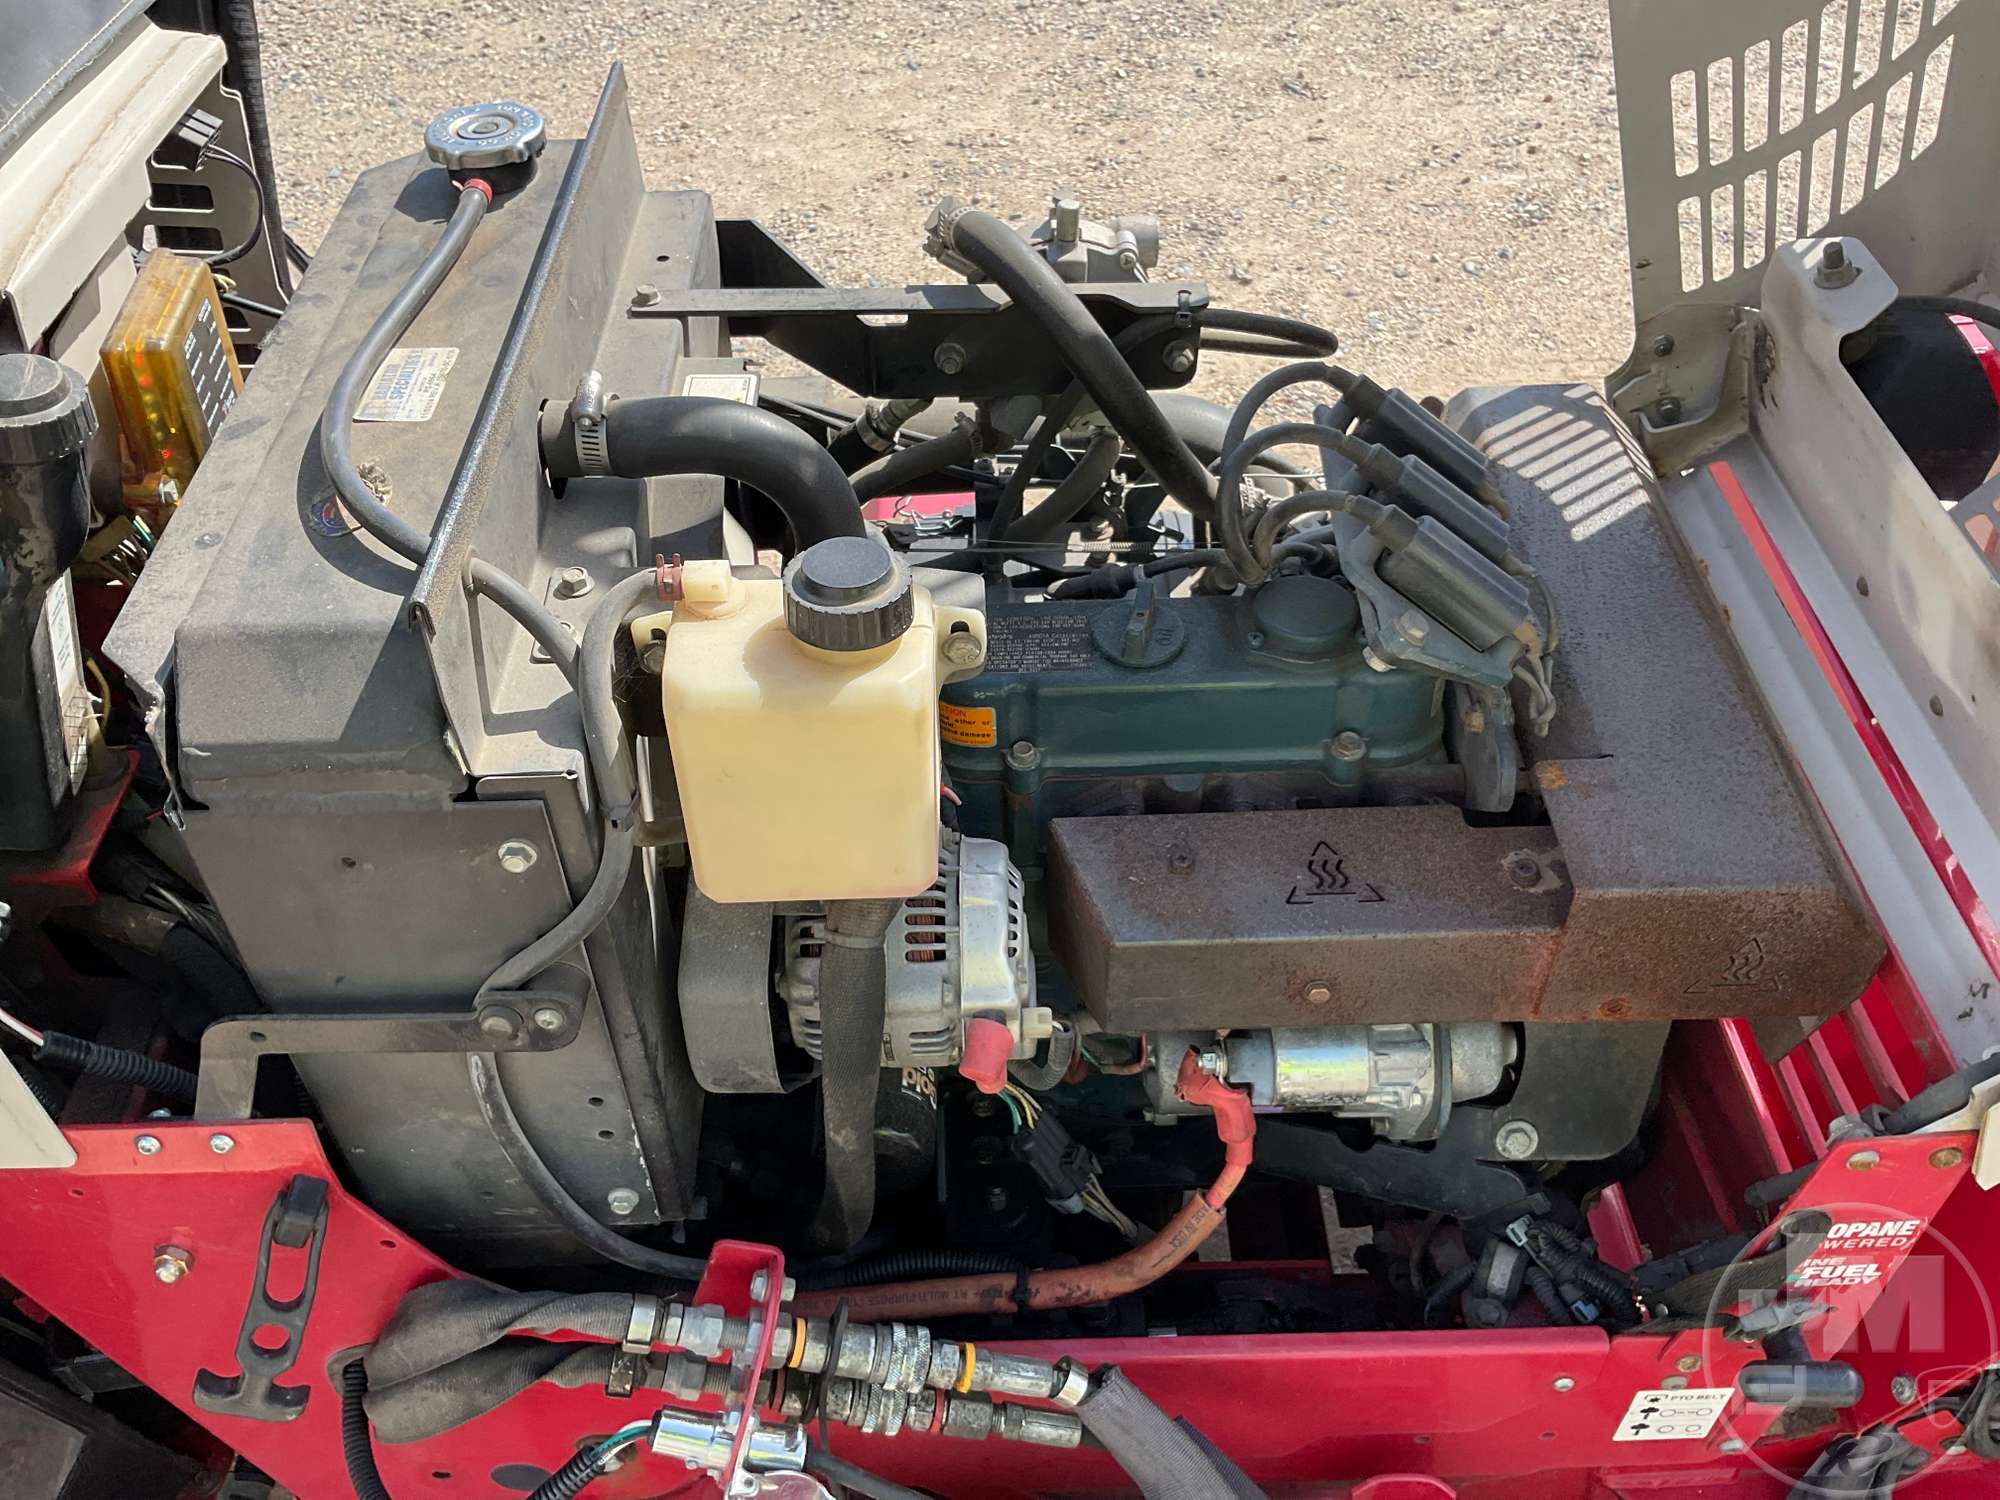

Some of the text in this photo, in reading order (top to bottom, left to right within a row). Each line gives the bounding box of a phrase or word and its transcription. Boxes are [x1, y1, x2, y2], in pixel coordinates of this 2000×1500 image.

[1826, 1219, 1921, 1239] OPANE
[1823, 1237, 1908, 1249] WERED
[1800, 1263, 1882, 1279] FUEL
